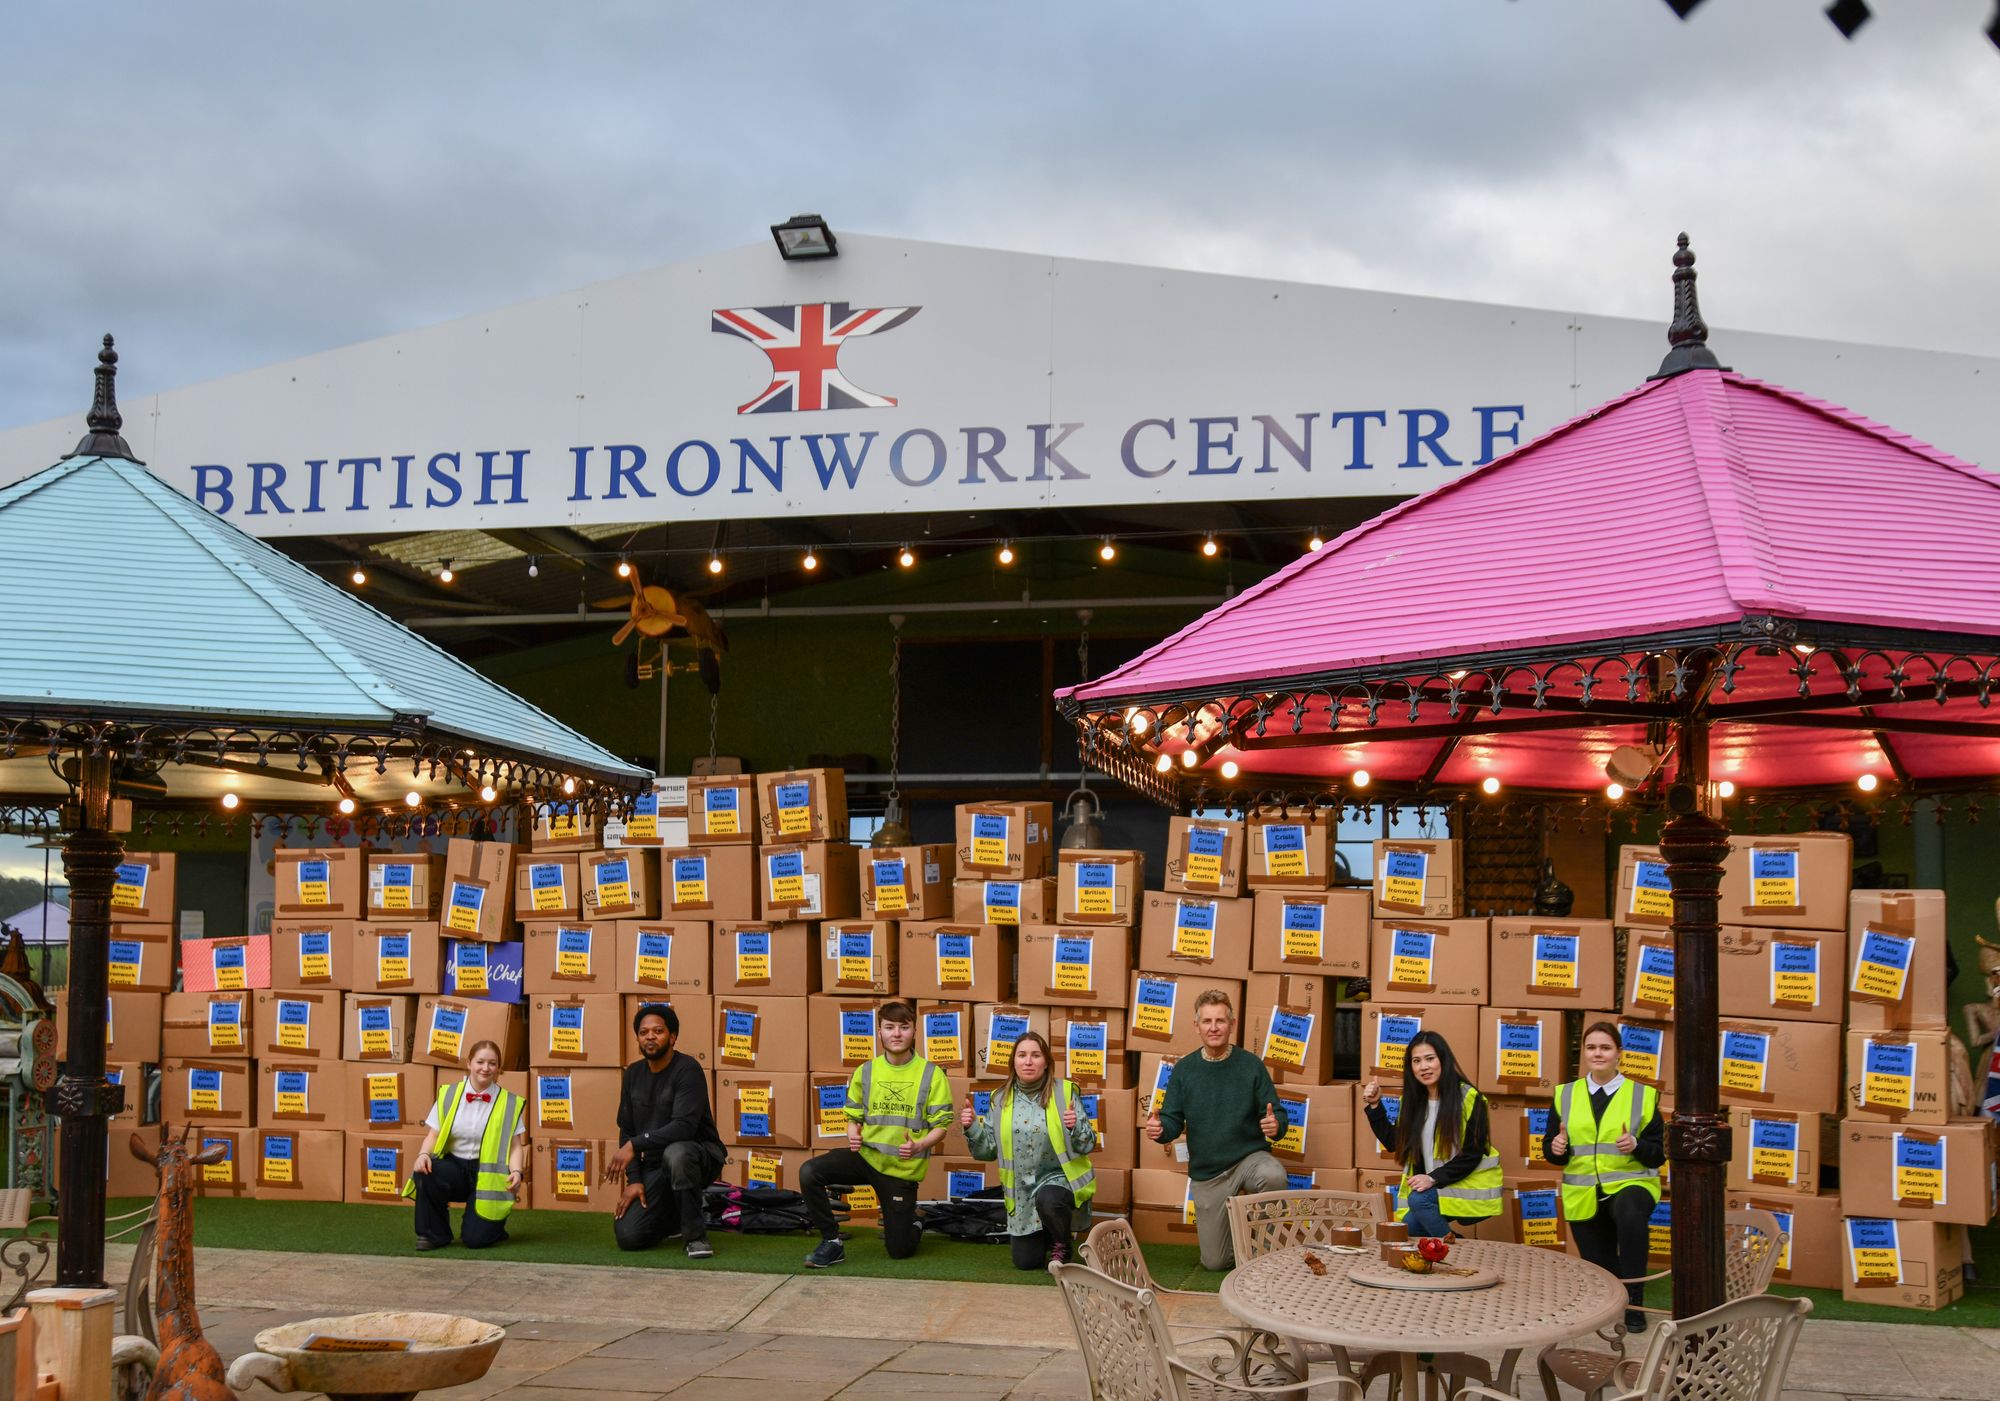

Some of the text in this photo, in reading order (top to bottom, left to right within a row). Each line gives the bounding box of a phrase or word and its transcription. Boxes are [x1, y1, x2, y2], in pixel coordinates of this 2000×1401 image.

[191, 404, 1525, 515] BRITISH IRONWORK CENTRE
[493, 963, 523, 985] Chef
[1868, 965, 1896, 977] British
[1861, 974, 1898, 987] Ironwork
[1863, 983, 1892, 995] Centre
[1139, 1015, 1168, 1023] Ironwork
[1141, 1023, 1164, 1031] Centre
[1730, 1062, 1756, 1071] British
[1724, 1071, 1760, 1080] Ironwork
[1728, 1080, 1754, 1089] Centre
[1874, 1076, 1903, 1085] British
[1868, 1086, 1907, 1095] Ironwork
[1872, 1095, 1902, 1104] Centre
[873, 1102, 890, 1110] BLACK
[891, 1103, 915, 1114] COUNTRY
[1761, 1150, 1786, 1159] British
[1756, 1160, 1791, 1168] Ironwork
[1906, 1170, 1934, 1178] British
[1901, 1180, 1939, 1188] Ironwork
[1905, 1190, 1934, 1198] Centre
[1864, 1270, 1891, 1278] Centre
